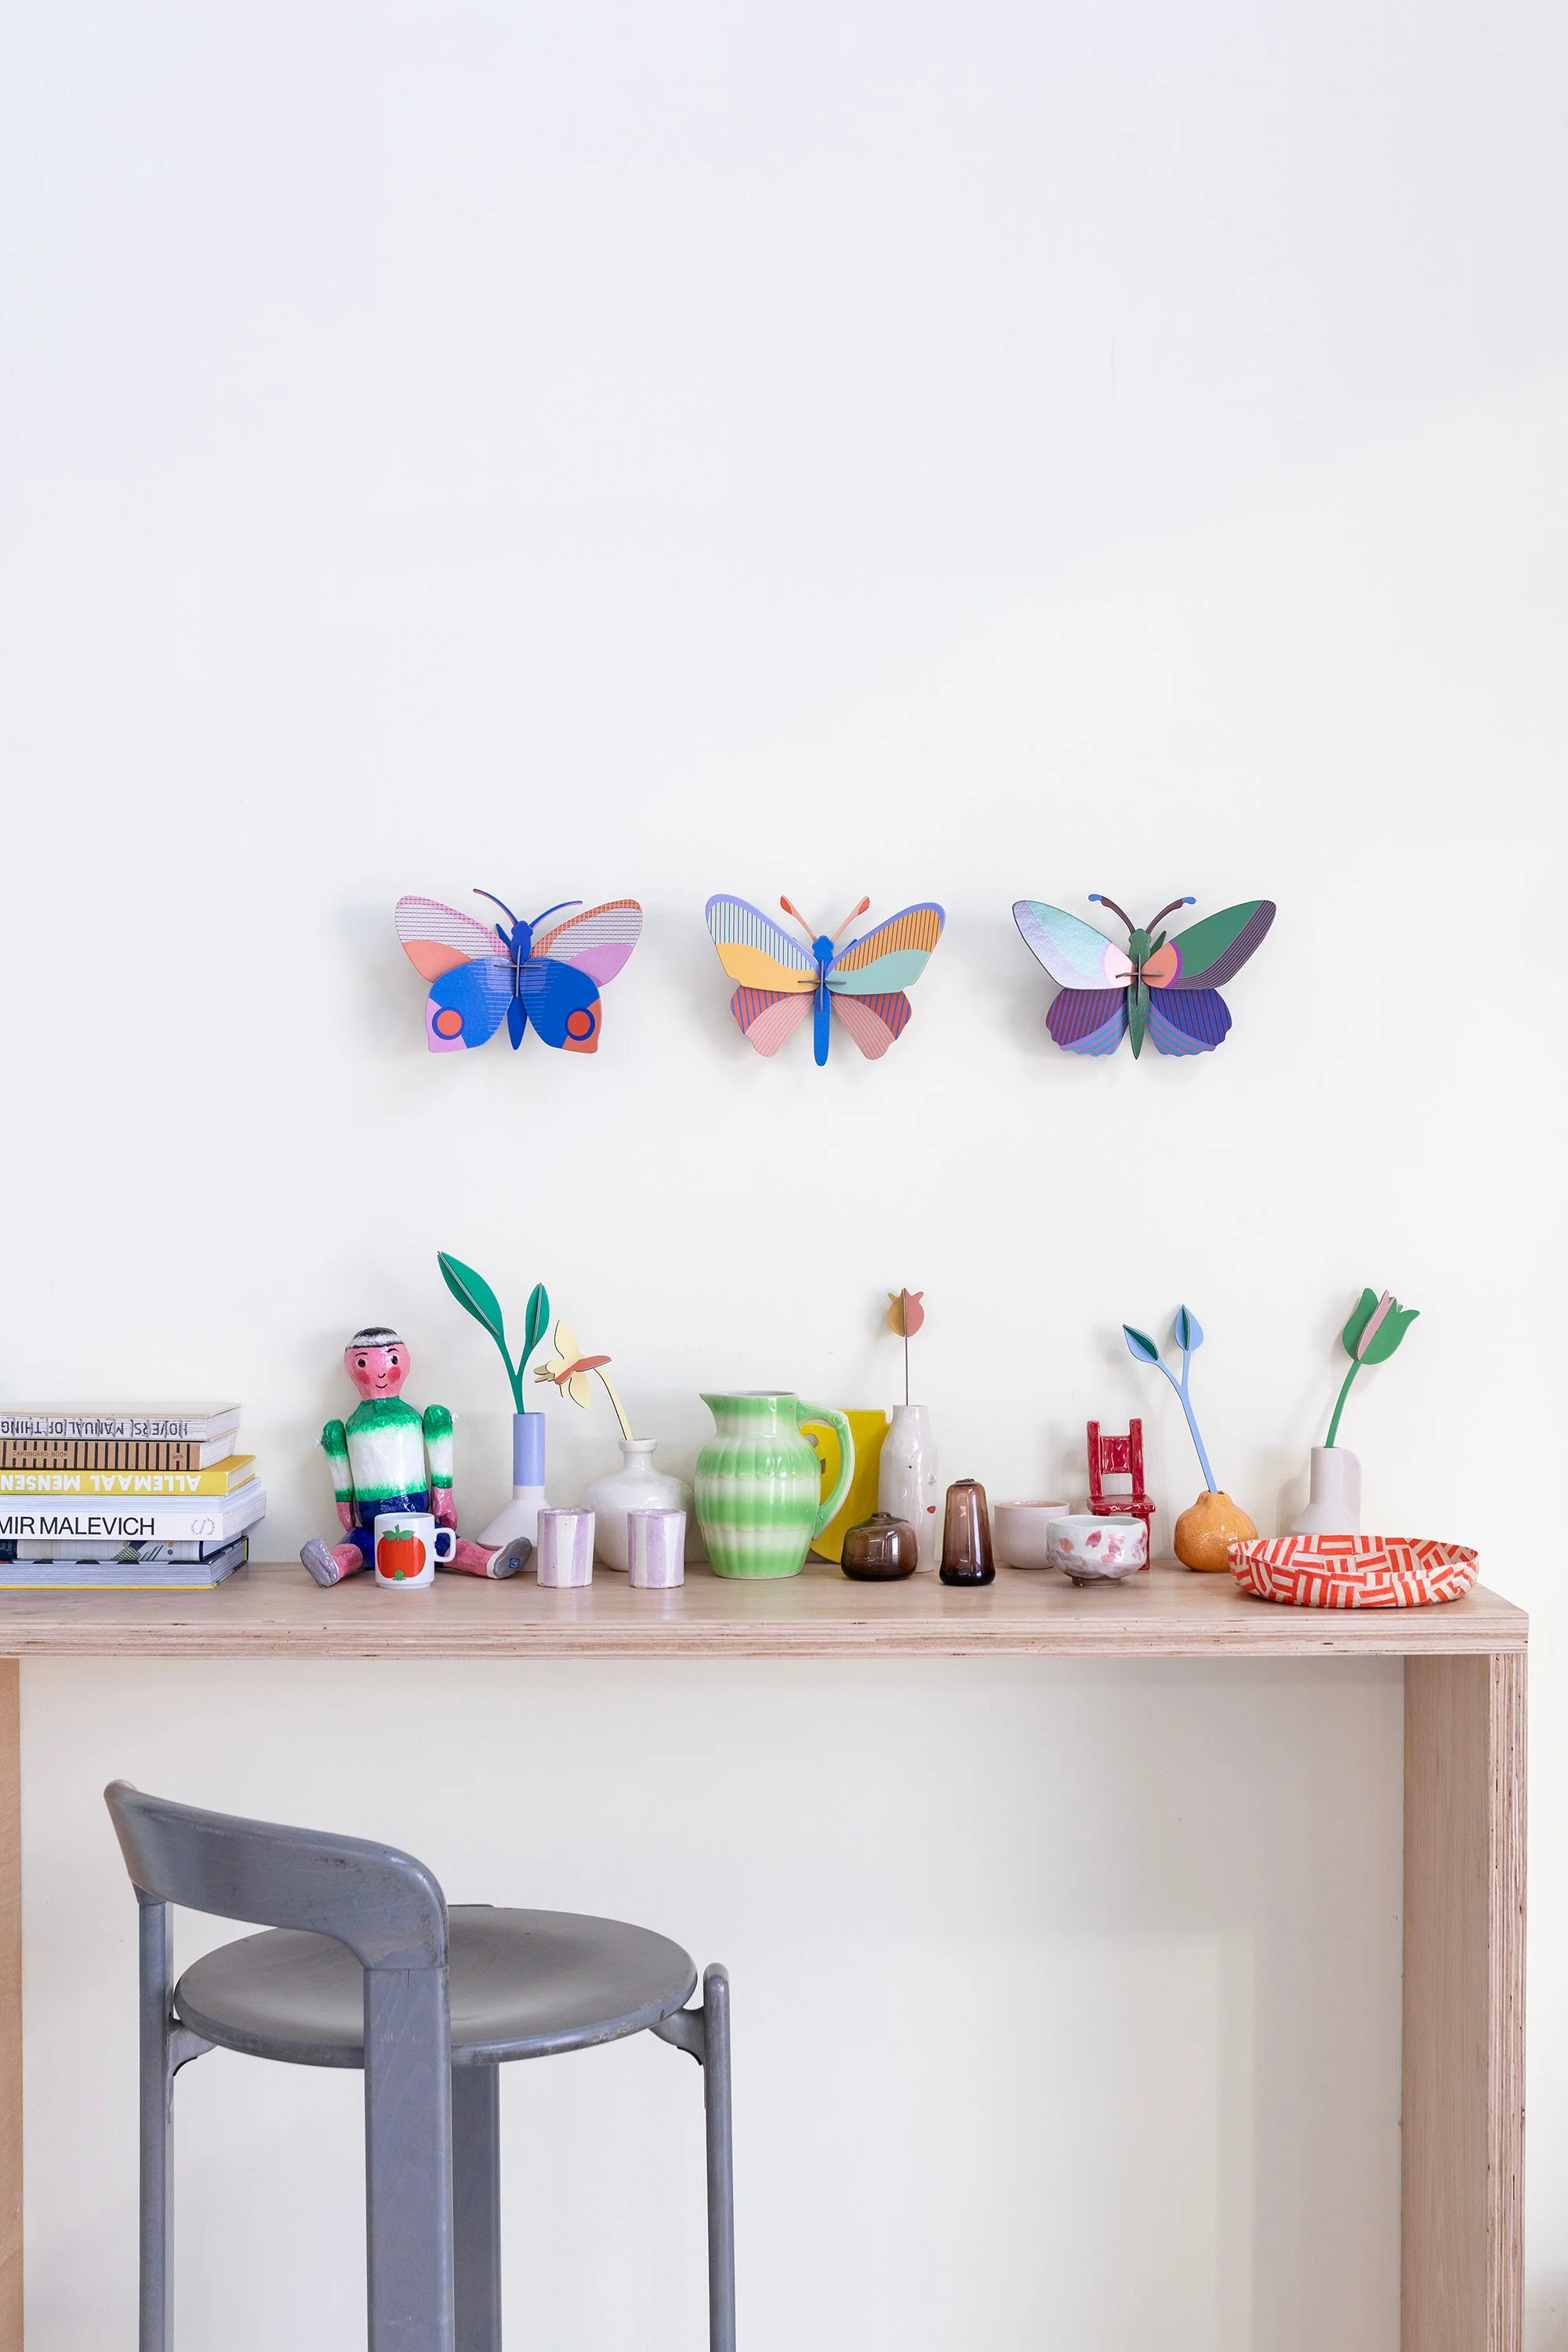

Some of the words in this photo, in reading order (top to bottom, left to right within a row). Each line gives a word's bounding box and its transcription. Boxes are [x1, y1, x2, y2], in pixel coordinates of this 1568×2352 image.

[48, 1421, 64, 1434] OF
[69, 1421, 124, 1435] MANUAL
[1, 1475, 80, 1491] MENSEN
[90, 1475, 201, 1491] ALLEMAAL
[40, 1516, 155, 1535] MALEVICH
